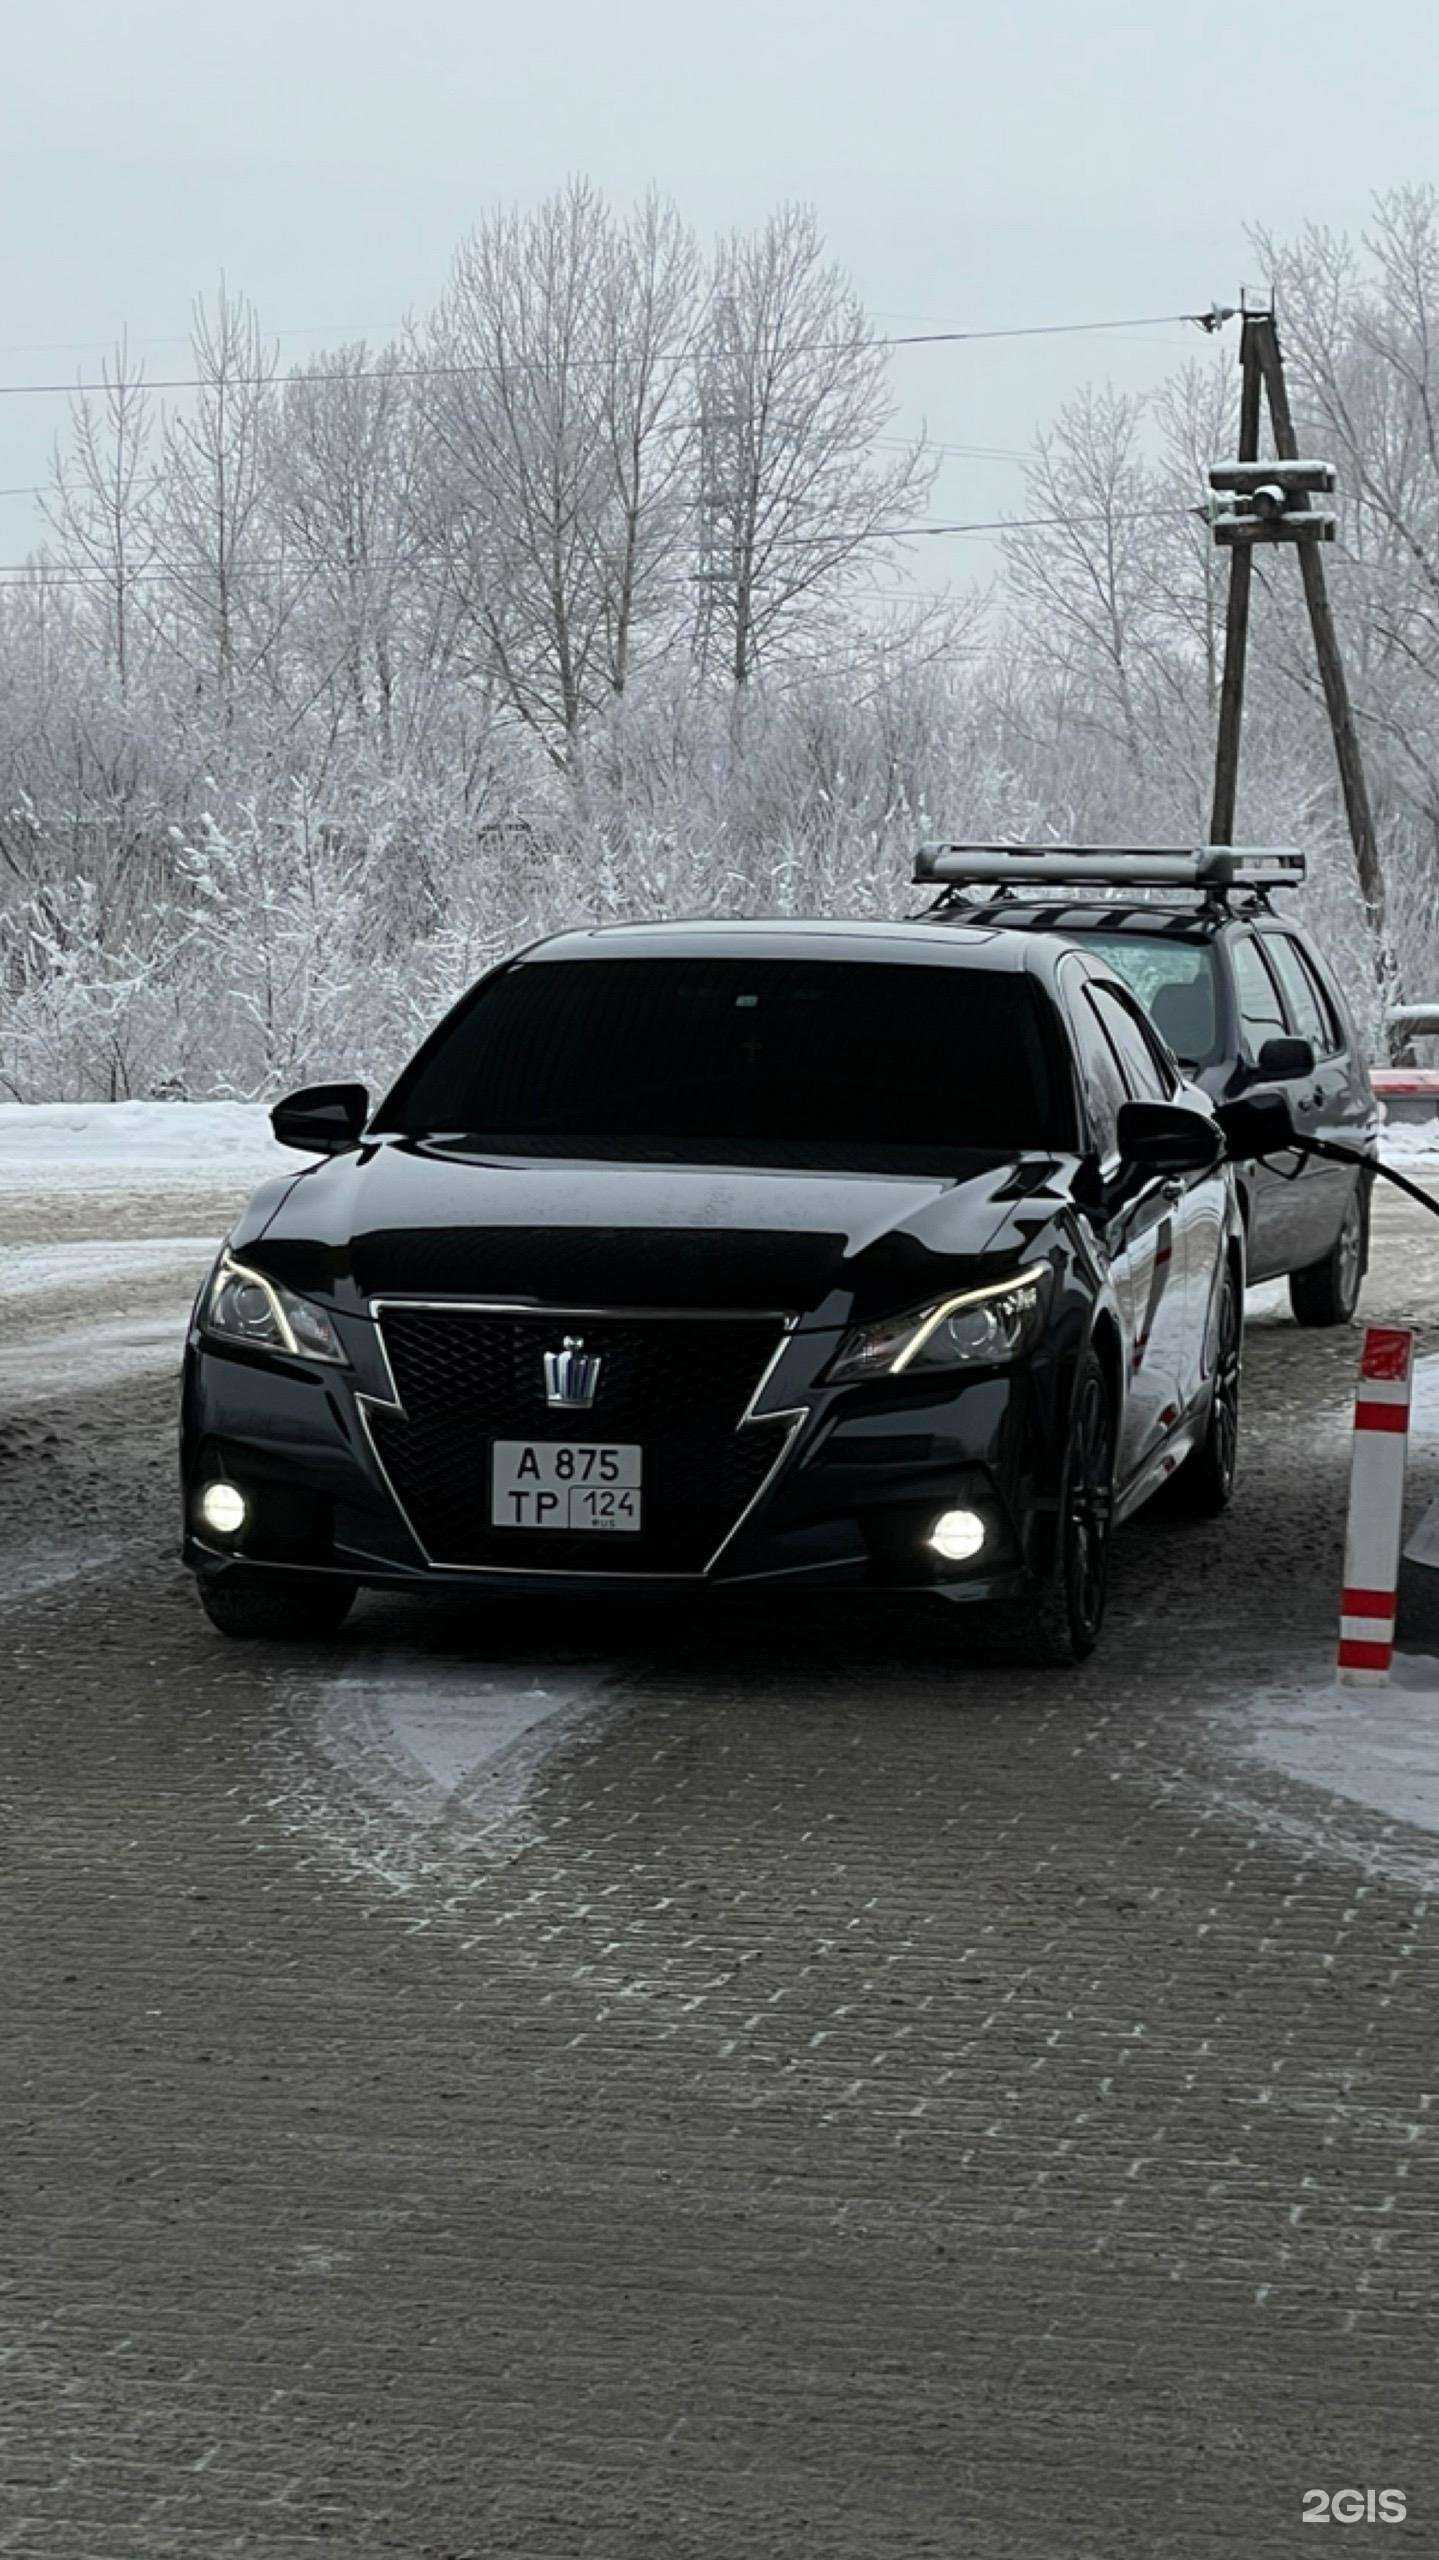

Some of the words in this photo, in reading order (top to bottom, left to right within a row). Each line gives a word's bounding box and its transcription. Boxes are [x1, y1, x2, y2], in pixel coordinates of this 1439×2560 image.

[517, 1447, 540, 1479] А
[555, 1448, 620, 1481] 875
[508, 1491, 559, 1524] ТР
[583, 1491, 634, 1516] 124
